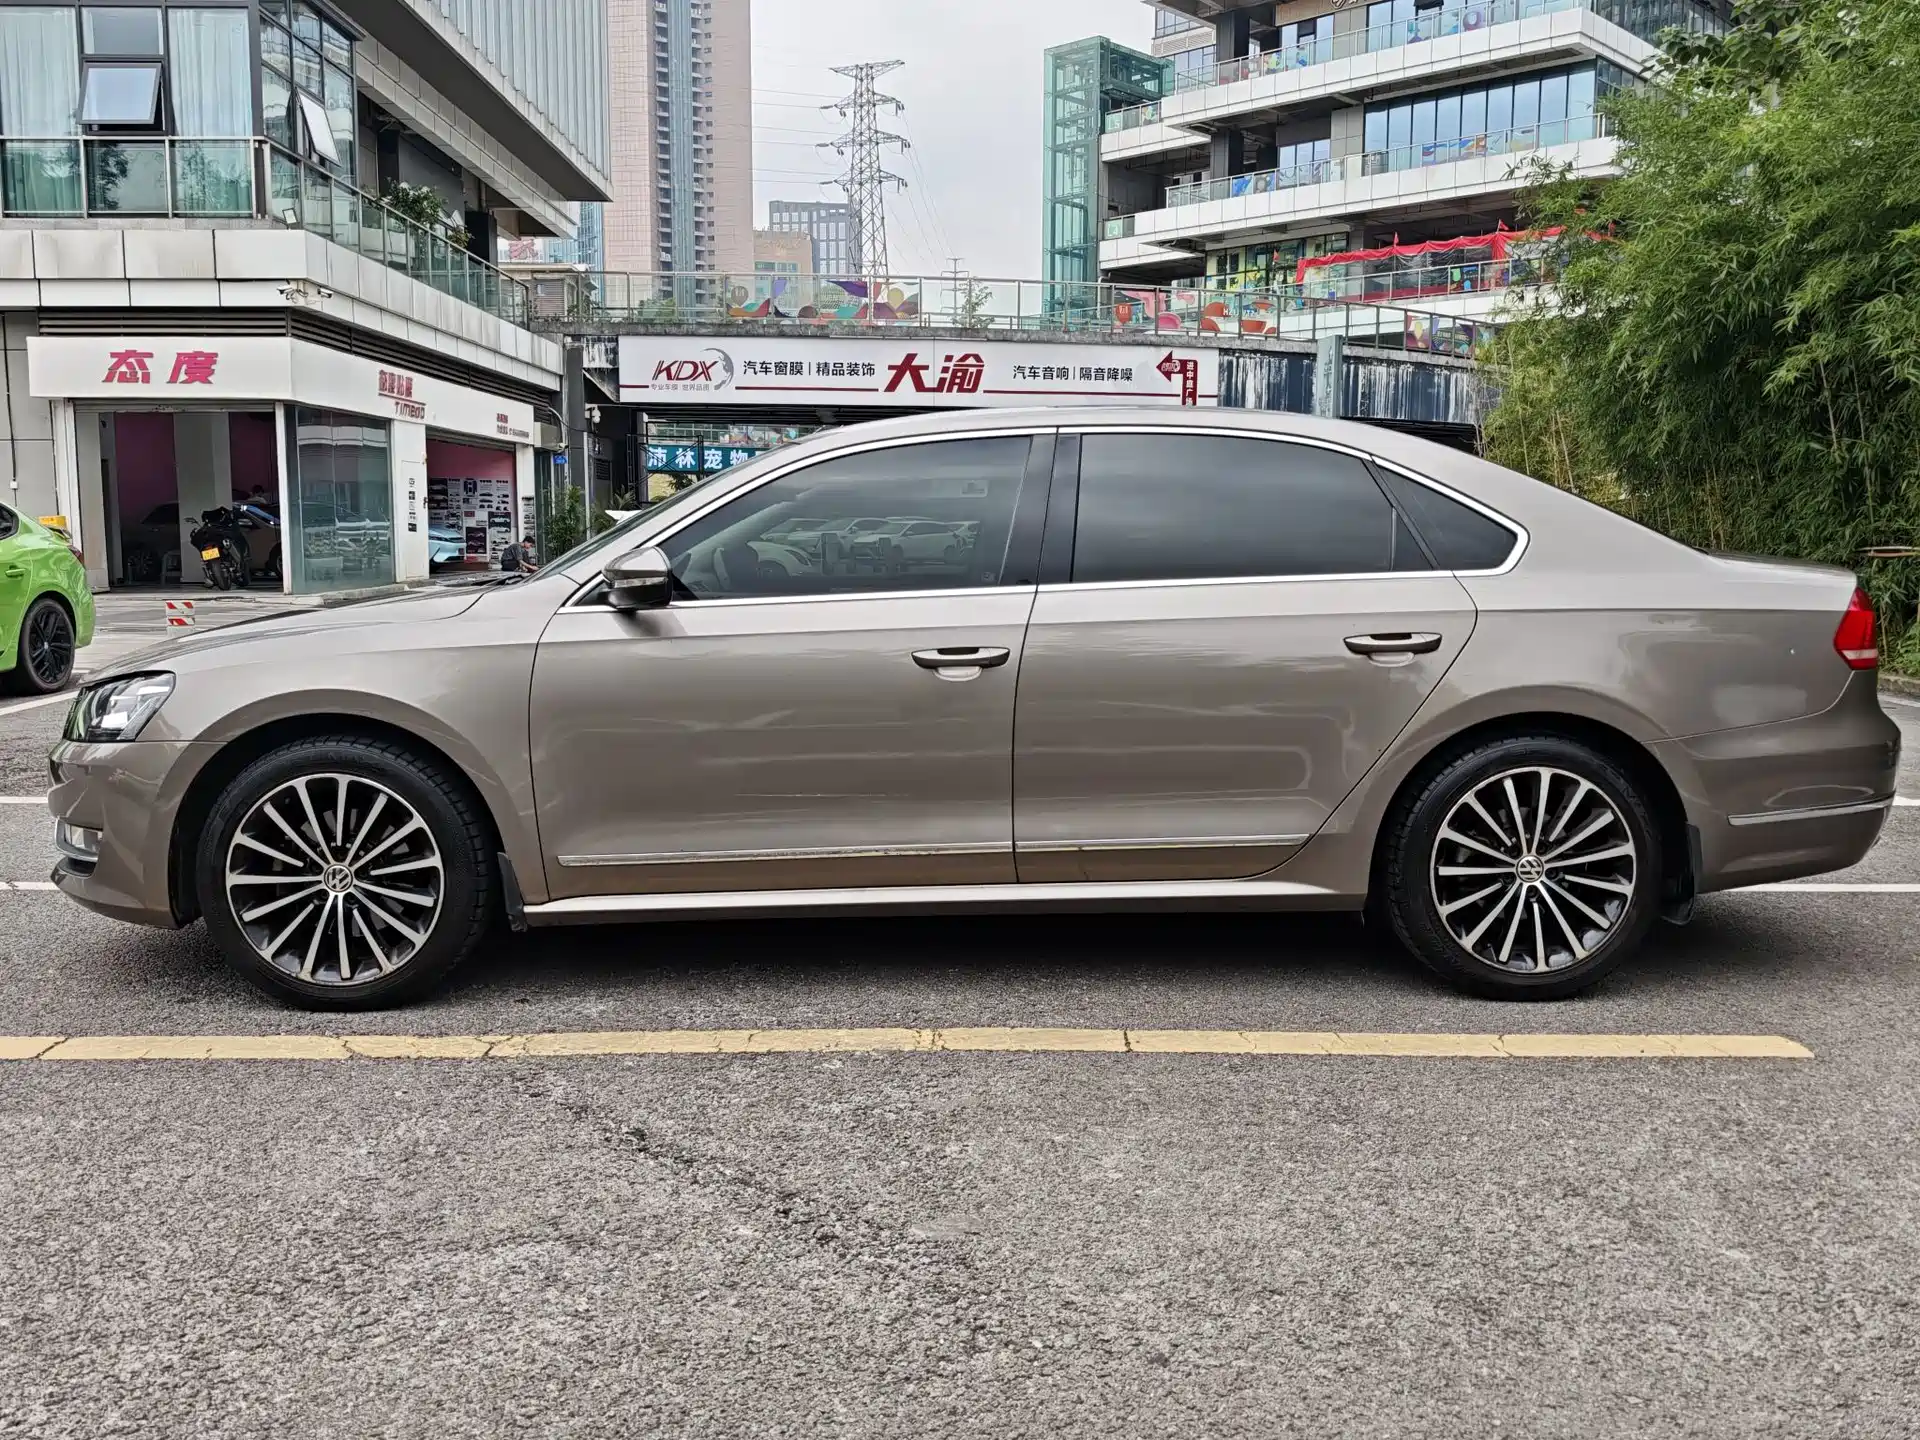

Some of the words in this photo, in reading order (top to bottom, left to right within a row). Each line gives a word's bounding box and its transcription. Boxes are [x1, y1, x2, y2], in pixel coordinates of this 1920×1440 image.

[101, 349, 219, 384] 态度
[652, 360, 719, 381] KDX
[743, 360, 804, 376] 汽车窗膜
[816, 361, 875, 377] 精品装饰
[884, 353, 985, 393] 大渝
[1012, 365, 1069, 380] 汽车音响
[1079, 366, 1133, 382] 隔音降噪
[647, 446, 765, 469] 沛林宠物
